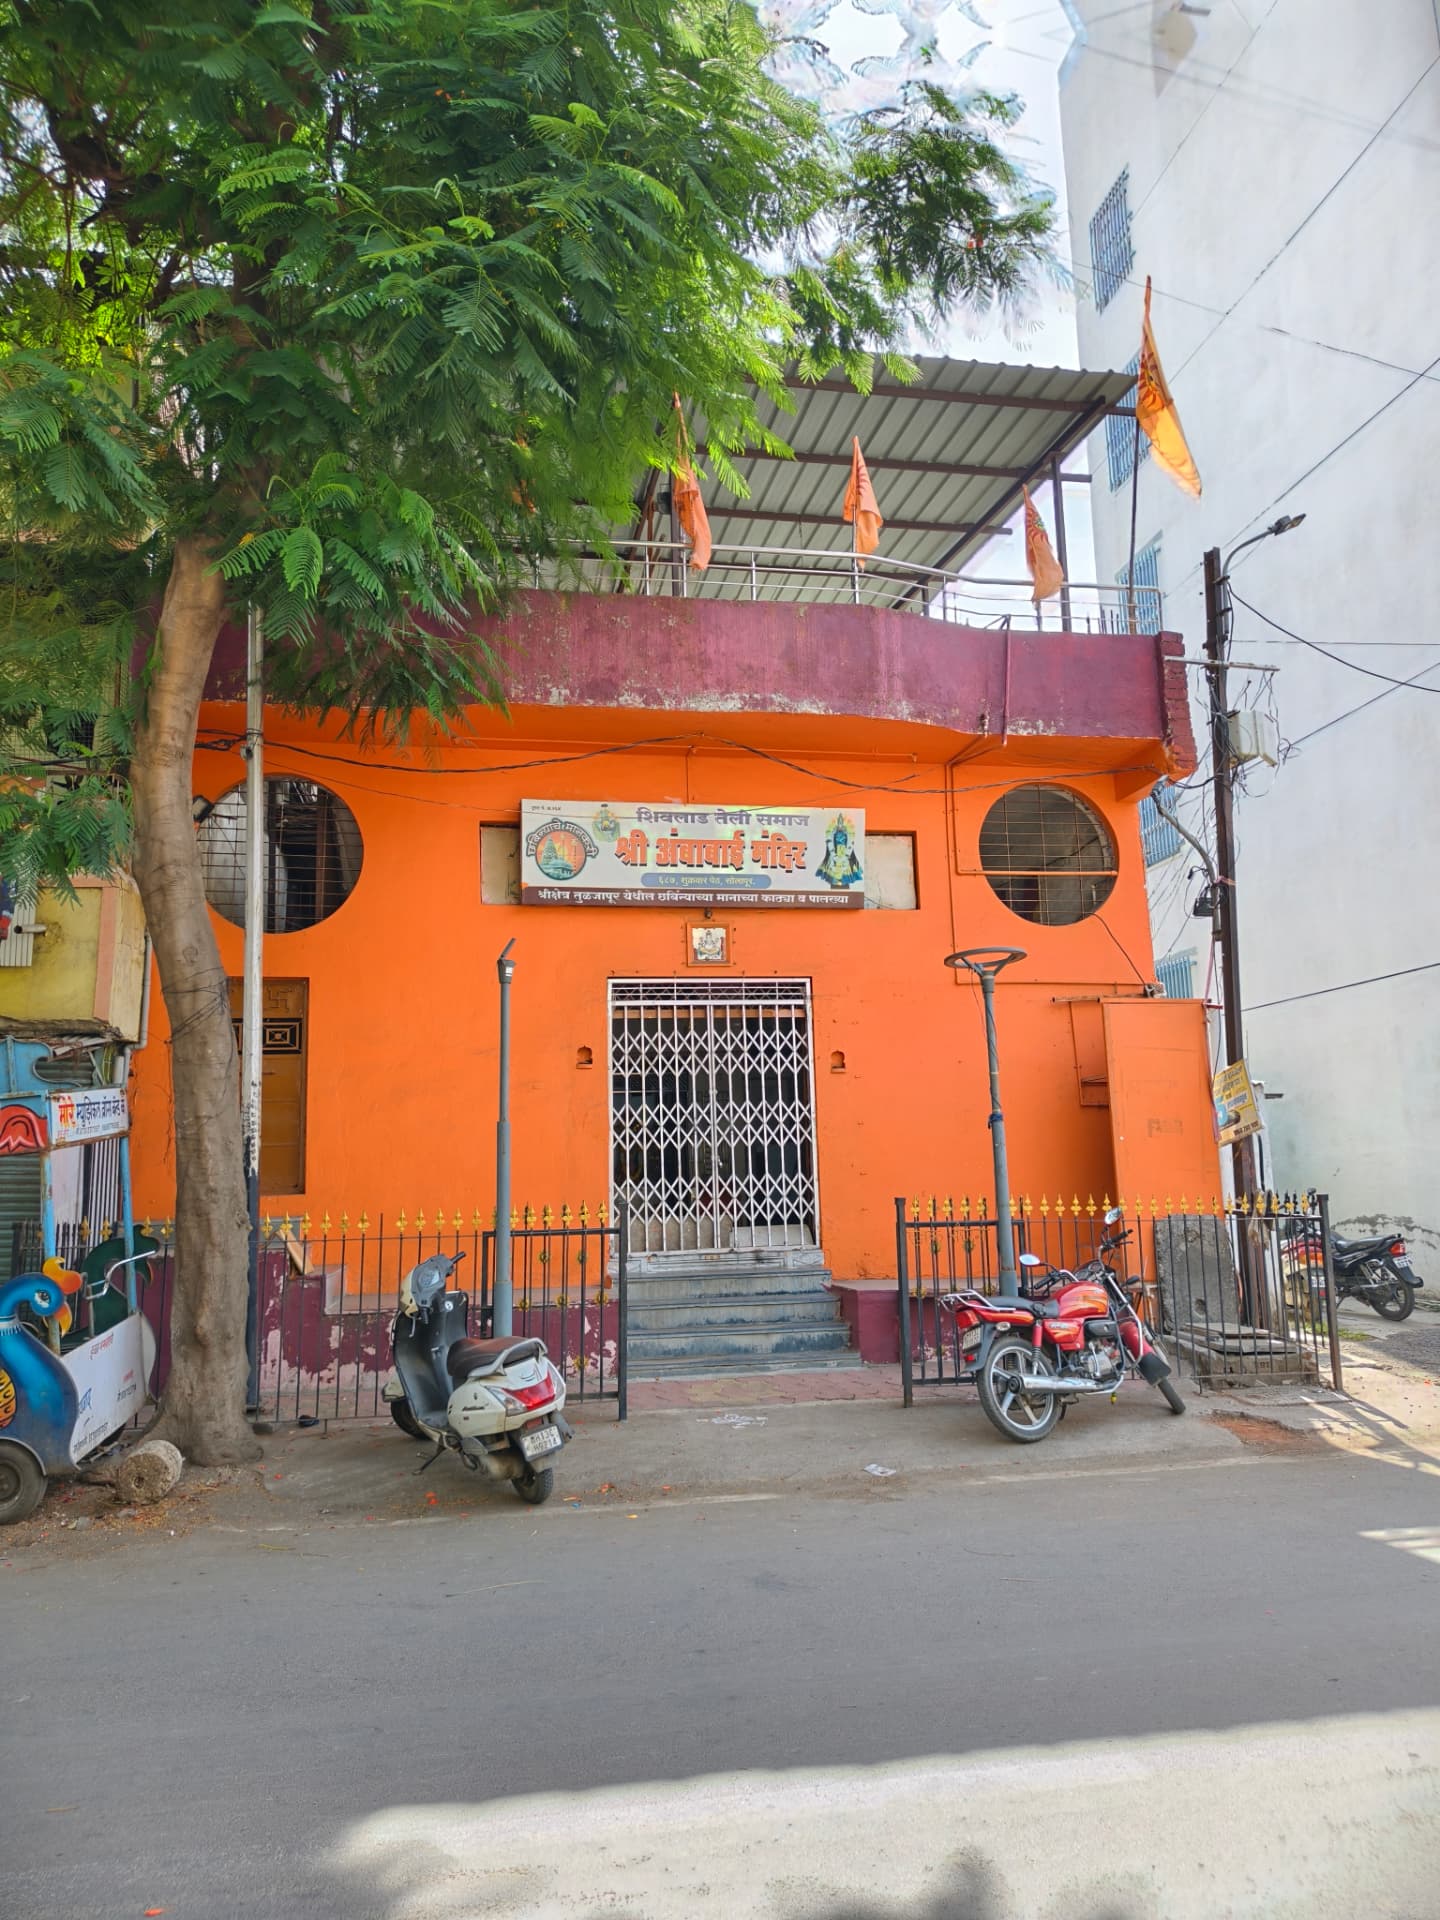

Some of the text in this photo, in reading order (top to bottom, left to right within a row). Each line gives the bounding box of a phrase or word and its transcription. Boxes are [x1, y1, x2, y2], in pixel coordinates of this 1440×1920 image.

[636, 807, 809, 827] शिवलाड तेली समाज
[614, 827, 808, 873] श्री अंबाबाई मंदिर
[538, 888, 570, 900] श्रीक्षेत्र
